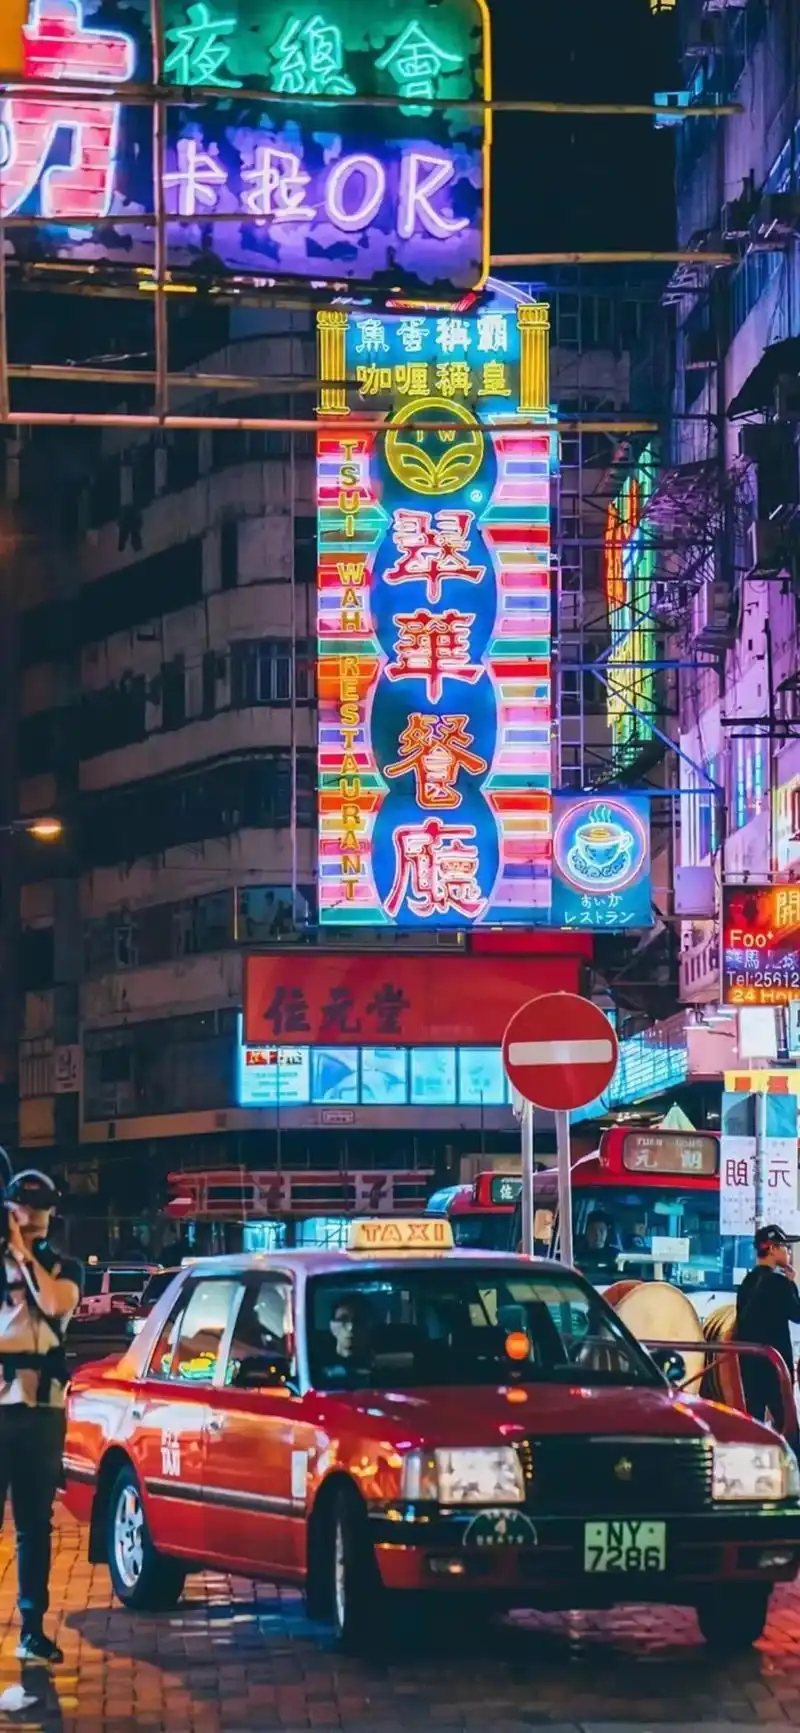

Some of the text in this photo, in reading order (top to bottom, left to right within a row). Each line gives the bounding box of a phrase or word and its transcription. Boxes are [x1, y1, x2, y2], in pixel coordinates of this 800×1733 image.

[164, 4, 463, 111] 夜總會
[336, 439, 364, 902] TSUI WAH RESTAURANT
[383, 508, 488, 918] 翠華餐廳
[564, 911, 635, 925] レストラン
[734, 988, 757, 1003] 24
[361, 1223, 445, 1242] TAXI
[606, 1520, 642, 1547] NY
[587, 1546, 661, 1572] 7286
